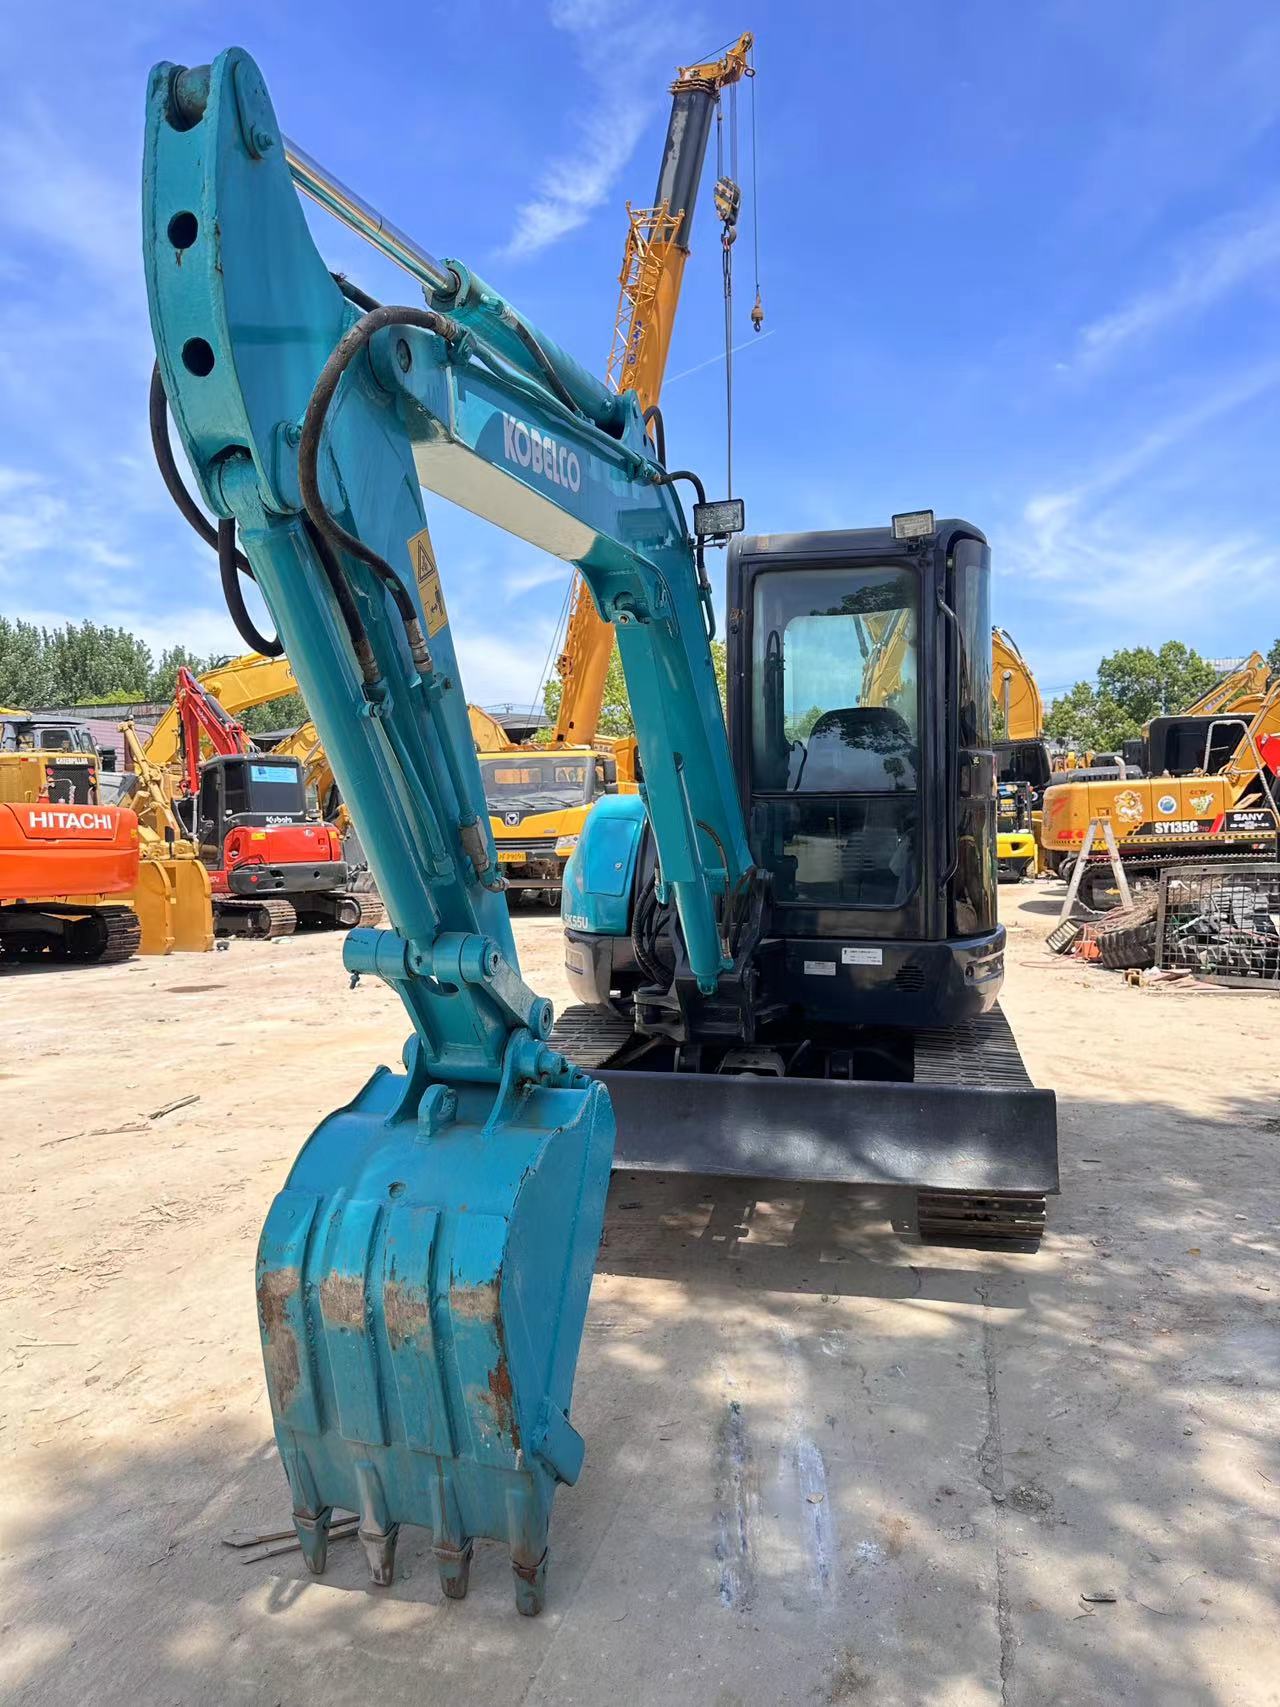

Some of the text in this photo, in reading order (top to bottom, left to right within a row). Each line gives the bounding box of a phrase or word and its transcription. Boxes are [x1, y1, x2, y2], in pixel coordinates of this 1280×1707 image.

[502, 411, 581, 493] KOBELCO
[29, 811, 113, 830] HITACHI
[1233, 812, 1265, 821] SANY
[1154, 820, 1198, 834] SY135C
